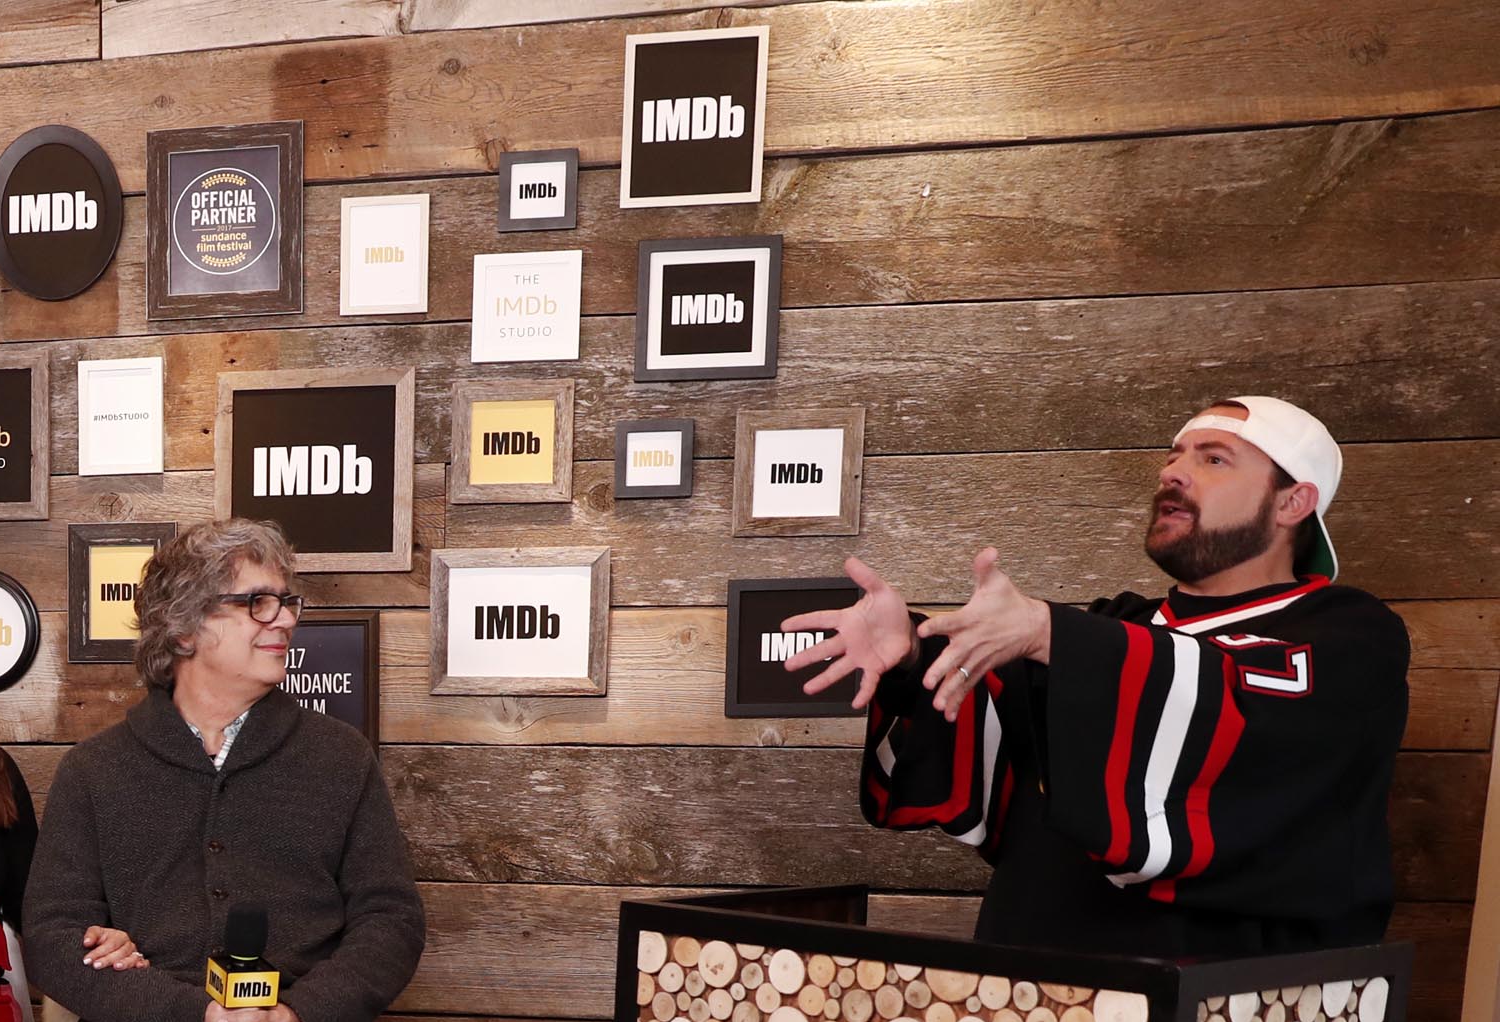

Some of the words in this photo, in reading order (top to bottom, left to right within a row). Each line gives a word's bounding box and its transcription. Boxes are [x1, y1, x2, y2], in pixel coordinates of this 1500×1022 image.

[641, 95, 745, 144] IMDb
[191, 189, 256, 209] OFFICIAL
[519, 182, 557, 199] IMDb
[8, 191, 98, 234] IMDb
[191, 206, 256, 226] PARTNER
[196, 244, 215, 252] film
[217, 241, 252, 251] festival
[201, 232, 247, 242] sundance
[364, 246, 404, 264] IMDb
[514, 274, 540, 286] THE
[495, 295, 558, 318] IMDb
[671, 293, 744, 326] IMDb
[499, 326, 553, 338] STUDIO
[93, 412, 149, 421] #IMDbSTUDIO
[483, 432, 541, 455] IMDb
[632, 450, 674, 468] IMDb
[253, 445, 373, 497] IMDb
[770, 463, 823, 485] IMDb
[474, 605, 560, 640] IMDb
[234, 982, 271, 998] IMDb
